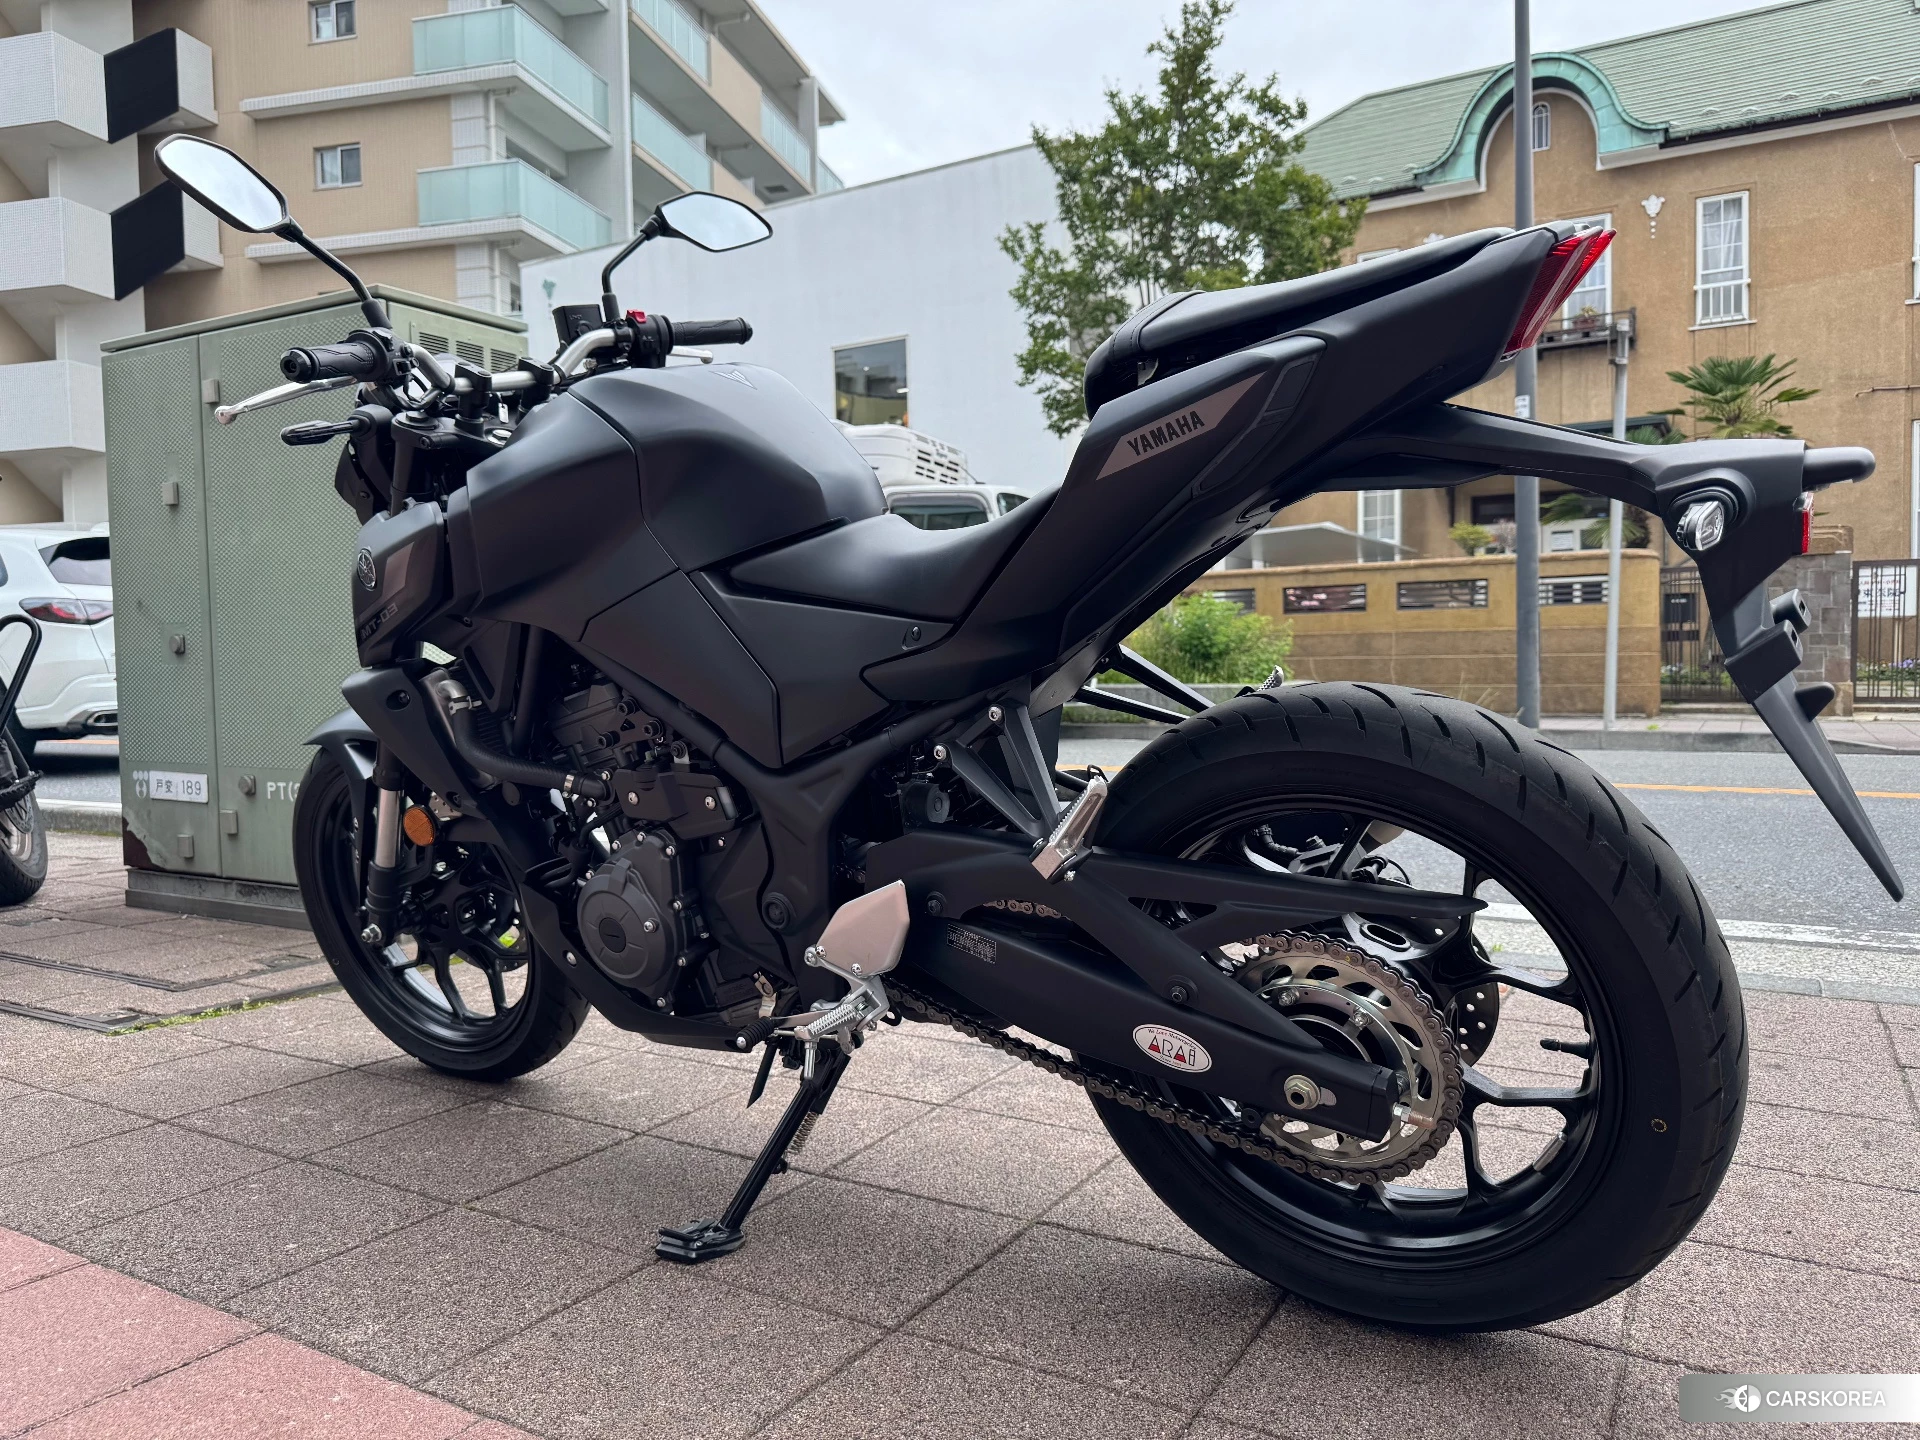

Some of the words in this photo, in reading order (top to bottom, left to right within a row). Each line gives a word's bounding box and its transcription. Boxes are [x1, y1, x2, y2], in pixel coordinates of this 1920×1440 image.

[1126, 410, 1205, 457] YAMAHA
[360, 602, 399, 640] MT-03
[181, 779, 202, 796] 189
